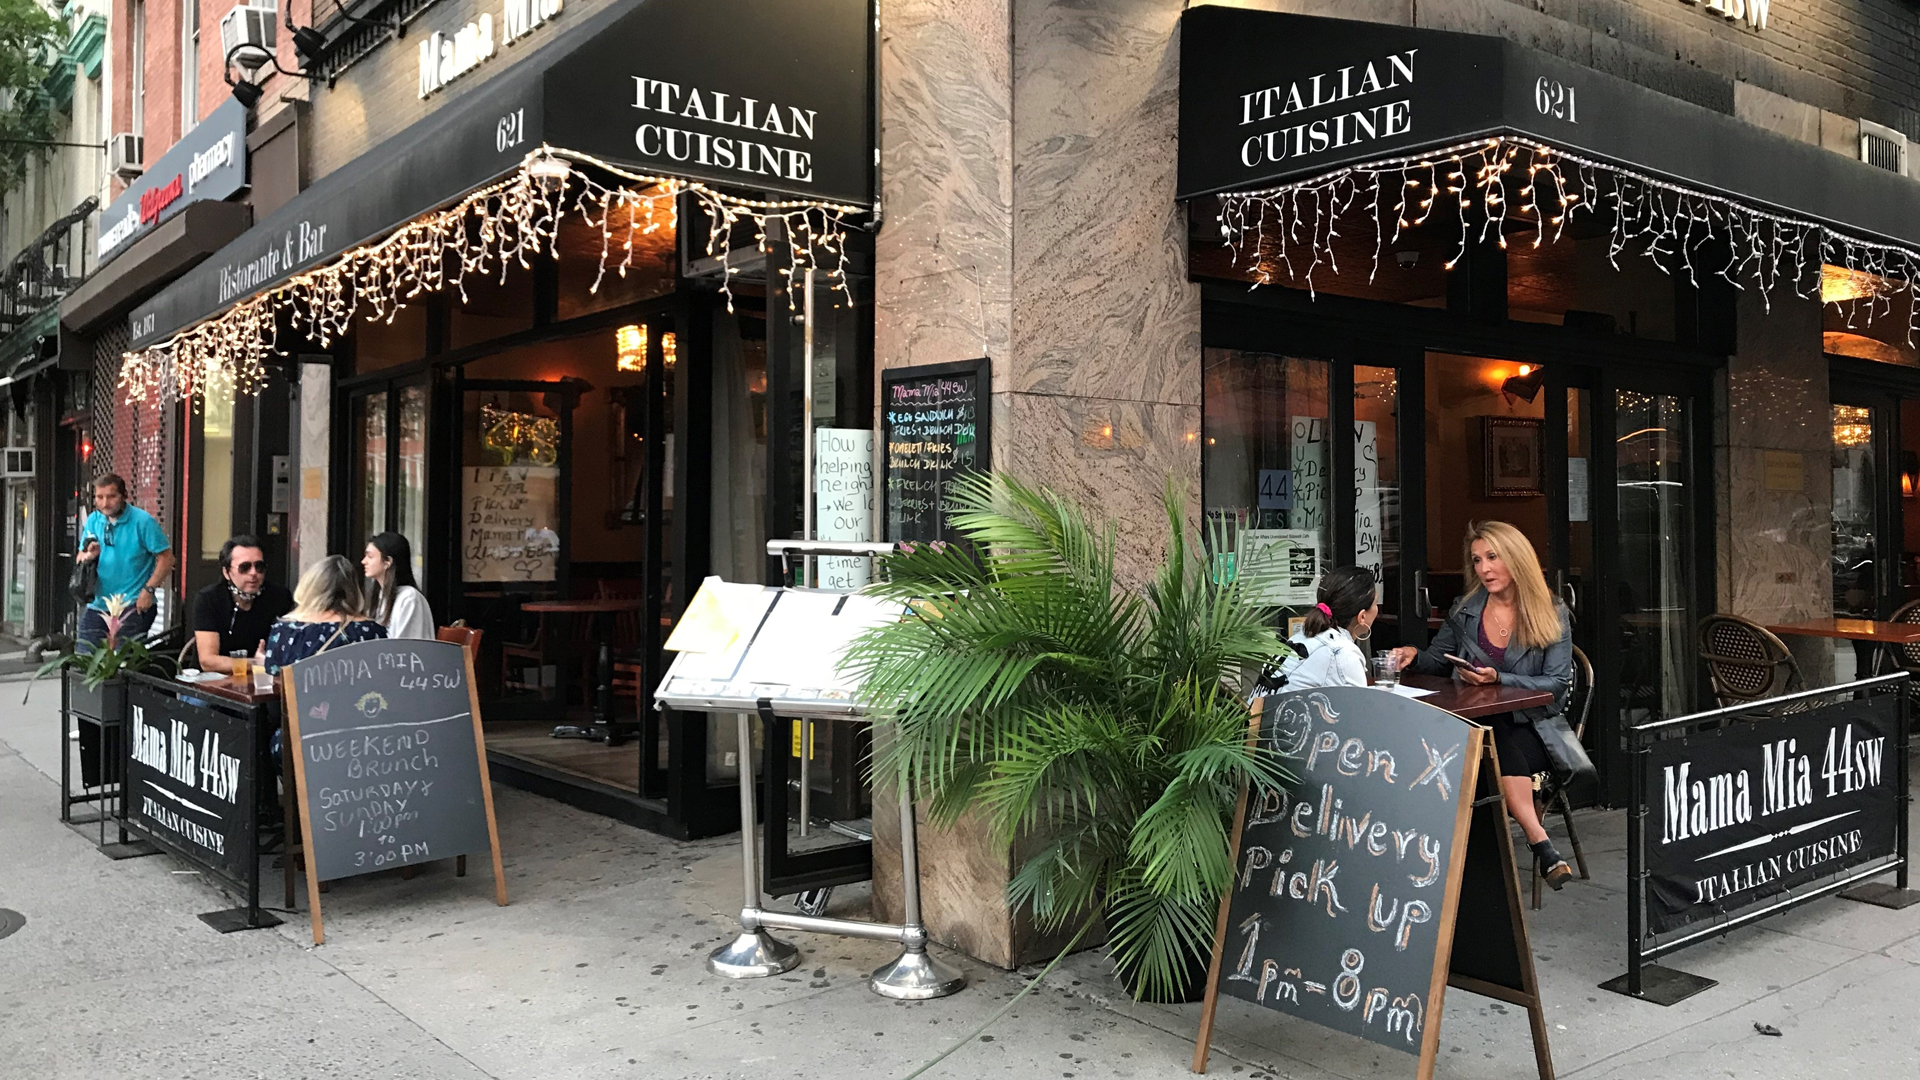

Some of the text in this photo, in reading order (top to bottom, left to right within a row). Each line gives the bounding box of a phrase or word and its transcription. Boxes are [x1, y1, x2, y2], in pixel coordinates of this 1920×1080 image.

[418, 13, 495, 99] Mama
[630, 75, 818, 140] ITALIAN
[1239, 49, 1419, 126] ITALIAN
[1534, 75, 1579, 125] 621
[496, 107, 526, 153] 621
[635, 123, 813, 182] CUISINE
[1241, 99, 1412, 168] CUISINE
[188, 130, 236, 195] pharmacy
[218, 220, 327, 304] Ristorante & Bar
[892, 384, 921, 403] Mama
[922, 383, 939, 404] Mia
[820, 454, 873, 479] helping
[1260, 474, 1288, 501] 44
[1215, 509, 1236, 523] Smking
[826, 555, 862, 570] time
[303, 652, 425, 693] MAMA MIA
[131, 704, 167, 775] Mama
[169, 718, 195, 788] Mia
[310, 729, 430, 763] WEEKEND
[1661, 761, 1753, 845] Mama
[1761, 738, 1813, 818] Mia
[142, 795, 225, 856] ITALIAN CUISINE
[1248, 783, 1441, 888] Delivery
[1693, 829, 1863, 905] ITALIAN CUISINE
